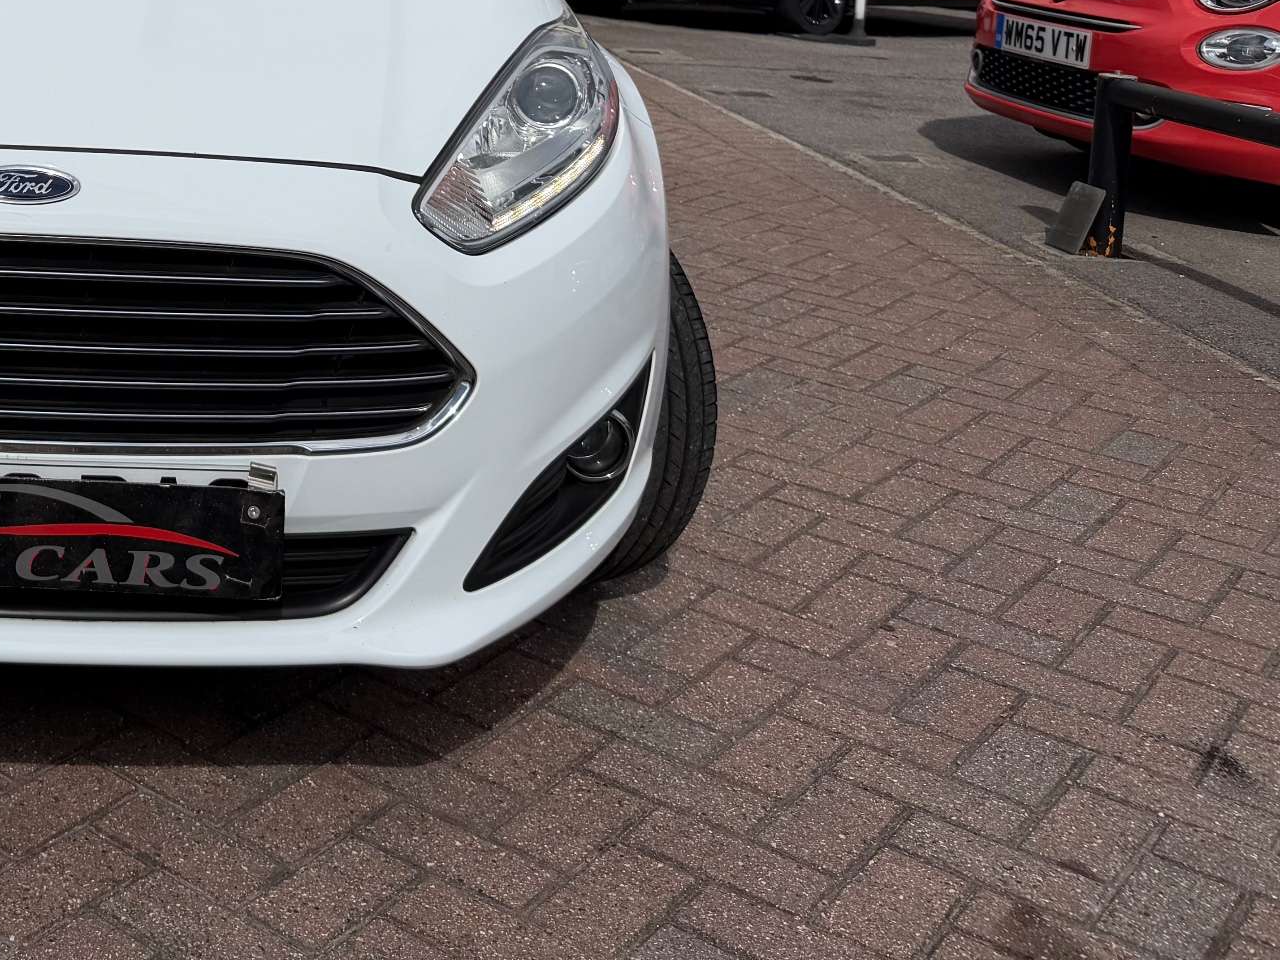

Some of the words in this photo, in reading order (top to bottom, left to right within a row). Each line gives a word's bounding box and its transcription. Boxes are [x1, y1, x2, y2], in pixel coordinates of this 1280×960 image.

[1005, 19, 1046, 53] WM65
[1051, 28, 1088, 62] VTW
[15, 544, 226, 591] CARS
